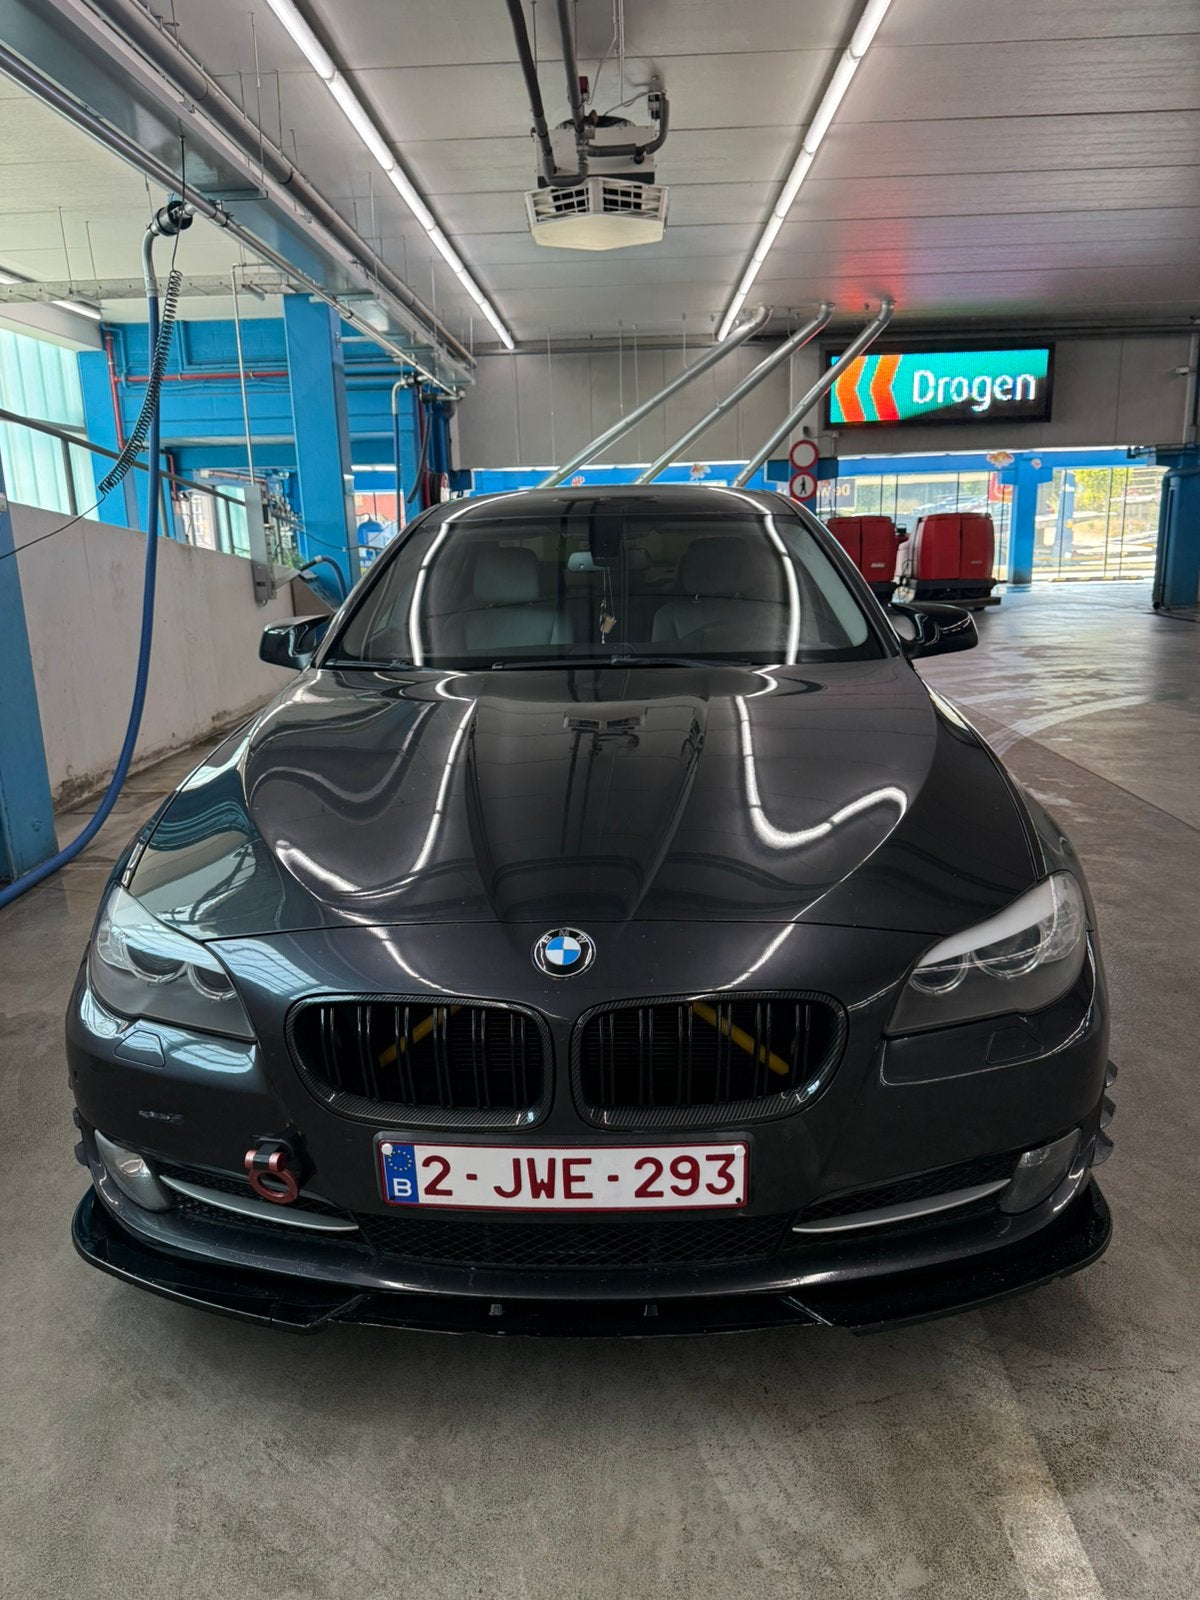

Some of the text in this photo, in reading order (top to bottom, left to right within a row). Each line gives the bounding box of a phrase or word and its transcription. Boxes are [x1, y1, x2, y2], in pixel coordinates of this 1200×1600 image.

[912, 369, 1036, 412] Drogen
[541, 928, 588, 944] BMW
[393, 1178, 412, 1197] B
